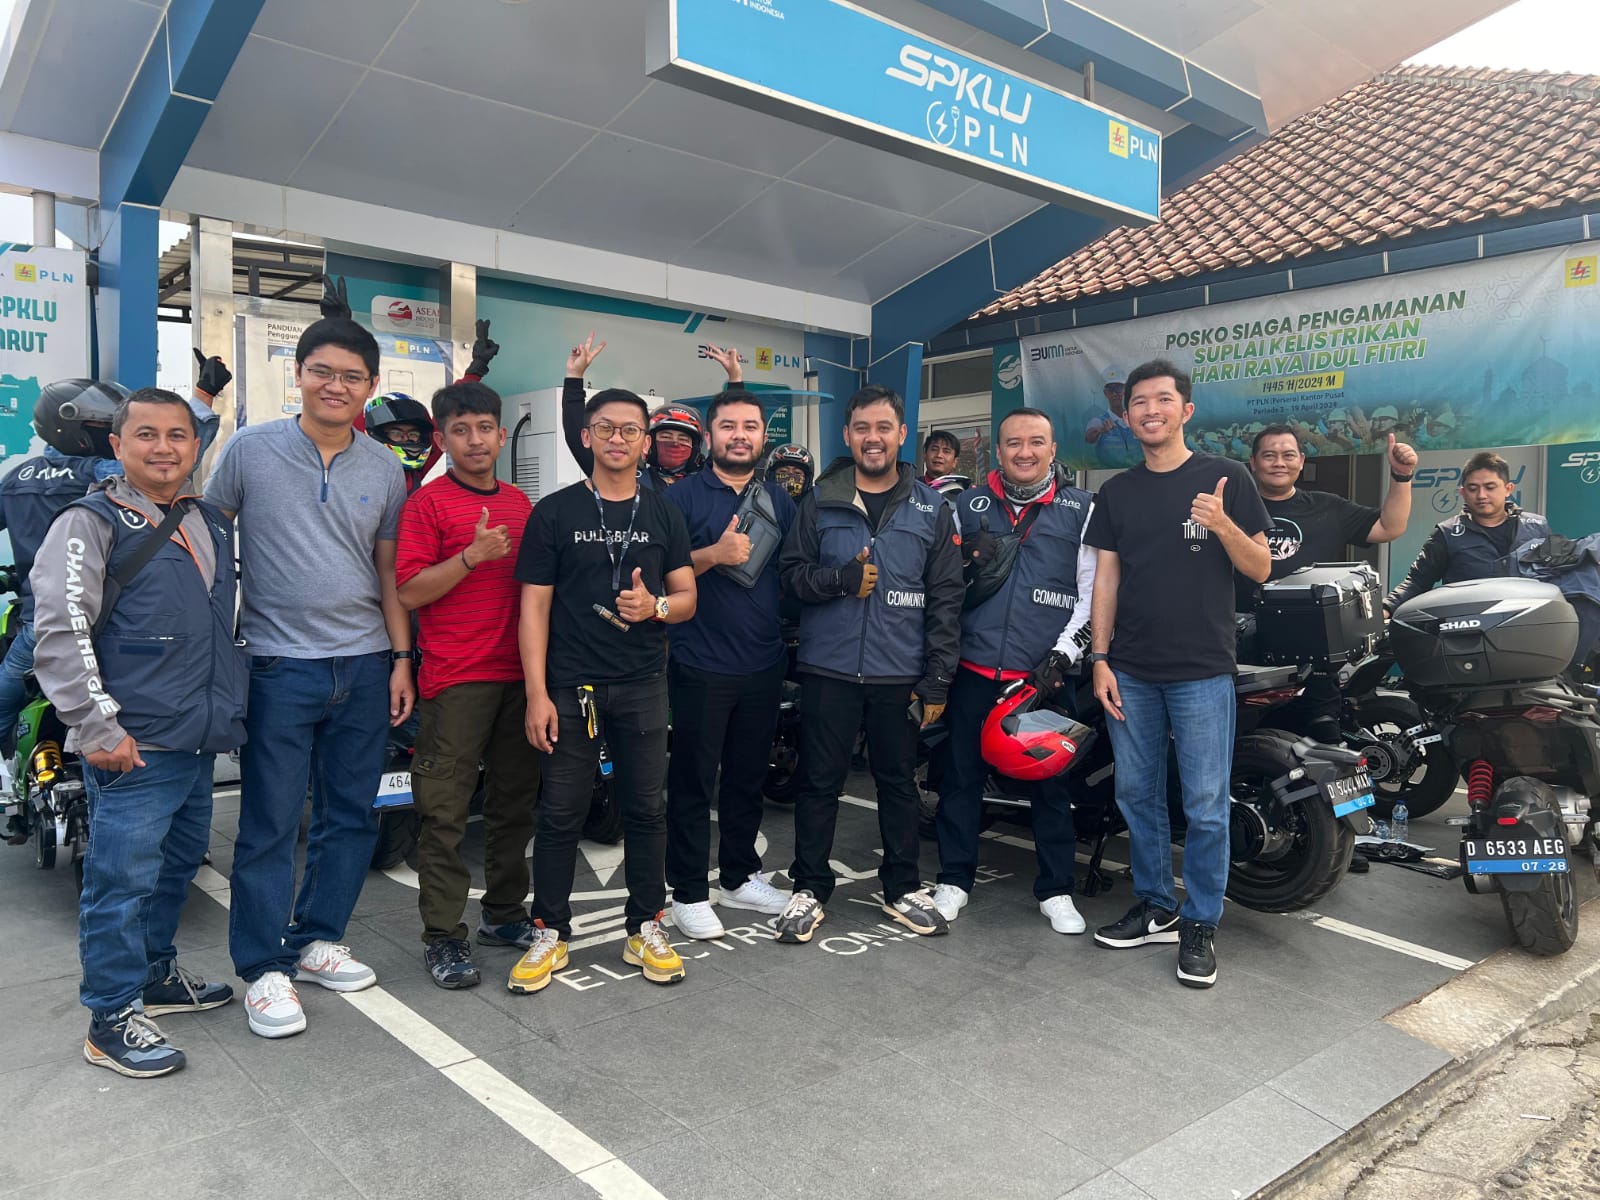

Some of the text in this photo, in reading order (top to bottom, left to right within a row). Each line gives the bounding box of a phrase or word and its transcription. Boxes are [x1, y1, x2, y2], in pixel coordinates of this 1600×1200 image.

[885, 44, 1032, 125] SPKLU
[964, 114, 1028, 166] PLN
[1130, 135, 1157, 163] PLN
[39, 270, 74, 283] PLN
[0, 296, 57, 322] PKLU
[1166, 290, 1467, 350] POSKO SIAGA PENGAMANAN
[409, 344, 430, 354] PLN
[1193, 317, 1422, 365] SUPLAI KELISTRIKAN
[774, 354, 800, 368] PLN
[1190, 338, 1428, 385] HARI RAYA IDUL FITRI
[1262, 381, 1284, 392] 1445
[1325, 391, 1345, 399] Pusat
[66, 537, 87, 632] CHANGE
[1439, 619, 1481, 631] SHAD
[1466, 839, 1564, 856] D 6533 AEG
